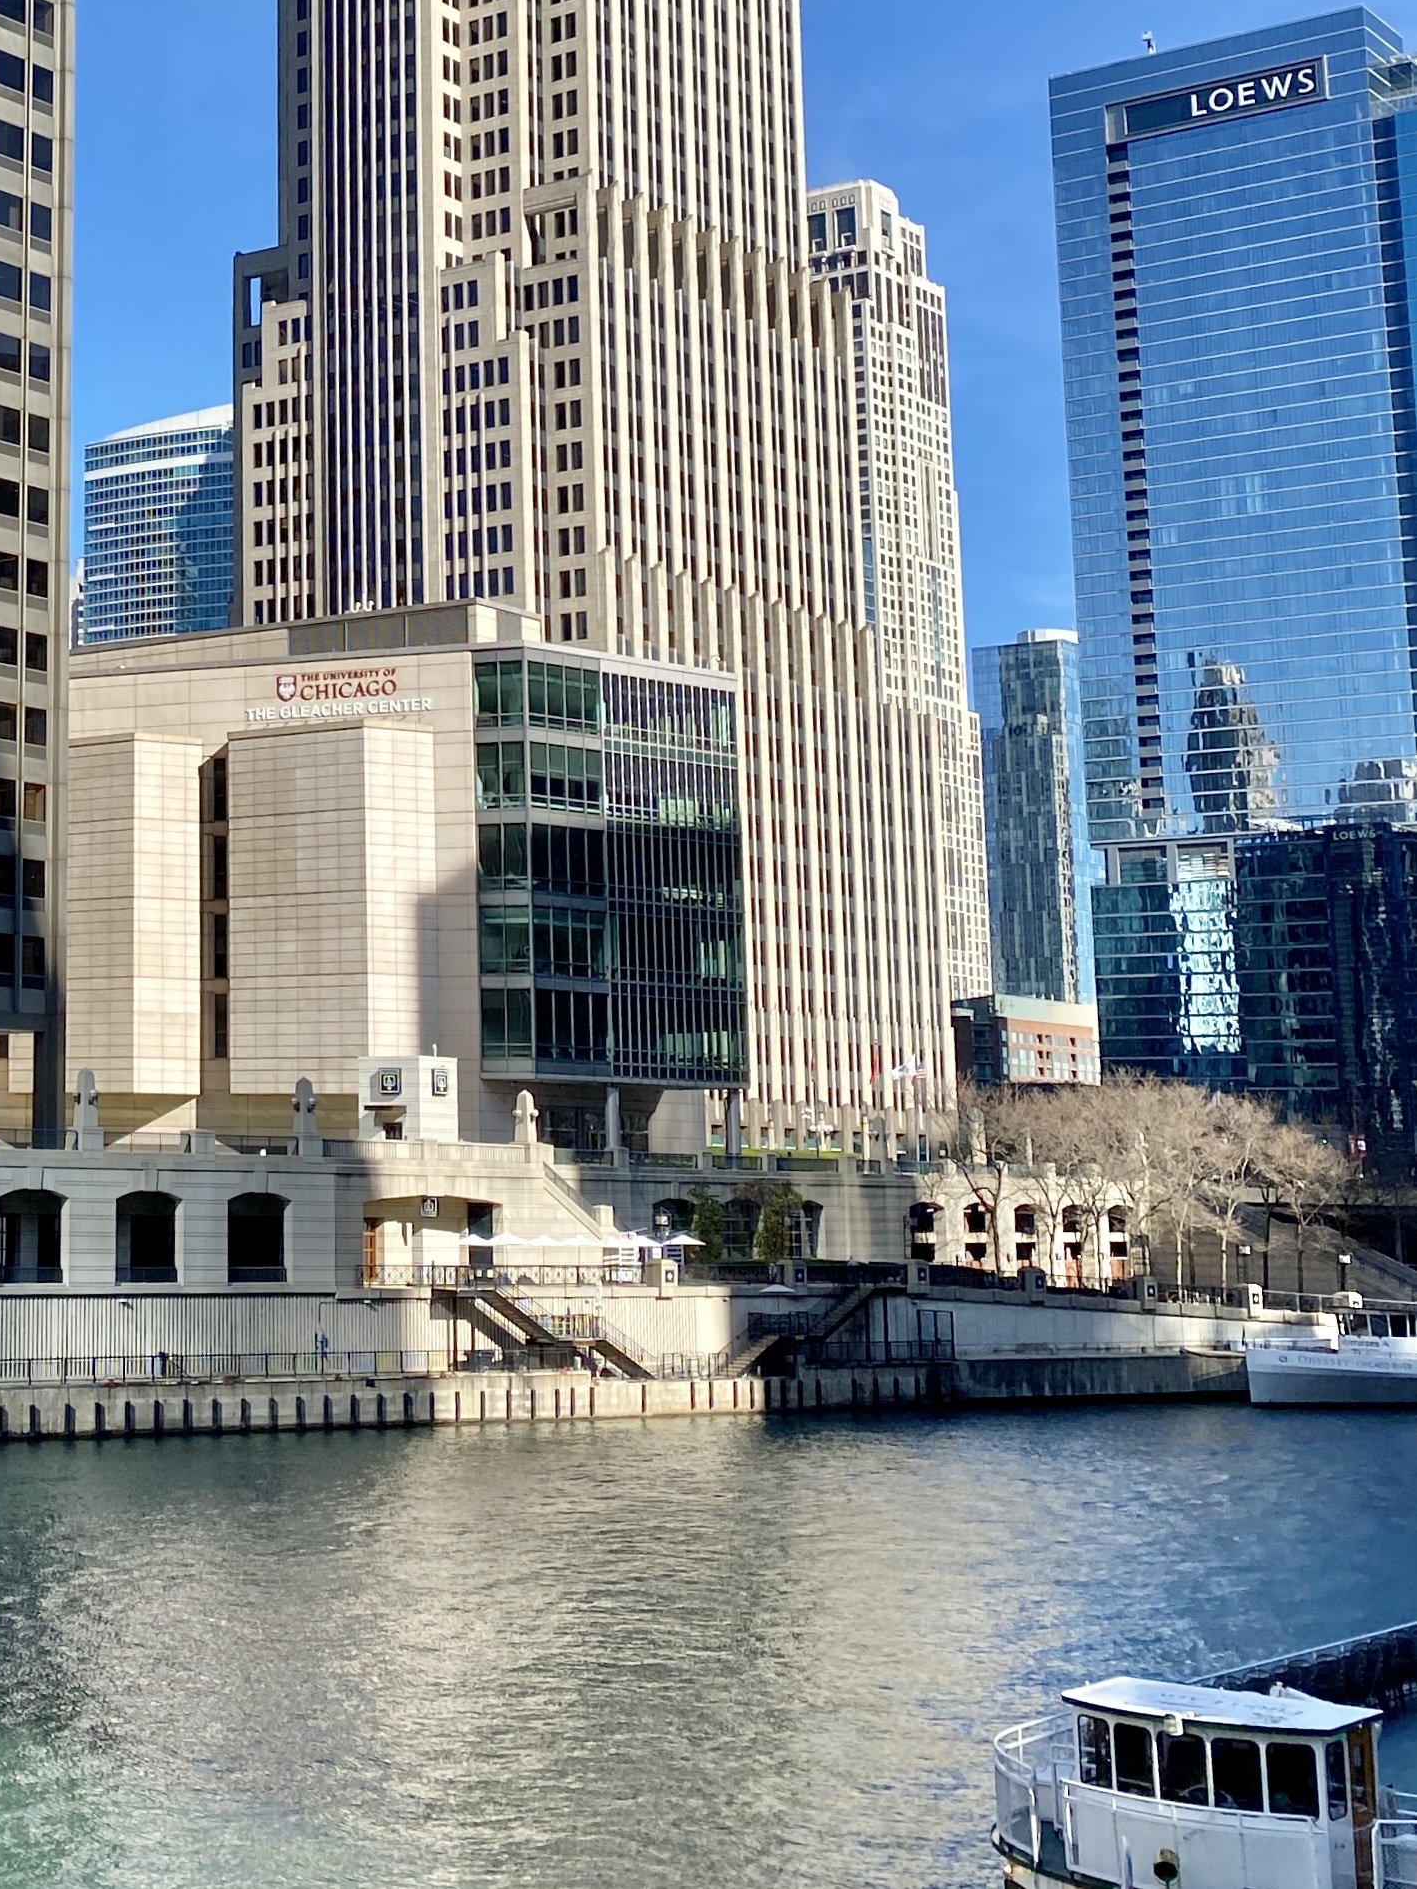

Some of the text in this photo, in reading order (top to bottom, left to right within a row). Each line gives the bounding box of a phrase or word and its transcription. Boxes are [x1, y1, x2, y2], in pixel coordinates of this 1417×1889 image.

[1190, 68, 1315, 117] LOEWS
[301, 668, 397, 682] THE UNIVERSITY OF
[300, 679, 397, 701] CHICAGO
[245, 697, 432, 721] THE GLEACHER CENTER
[1332, 829, 1377, 841] LOEWS
